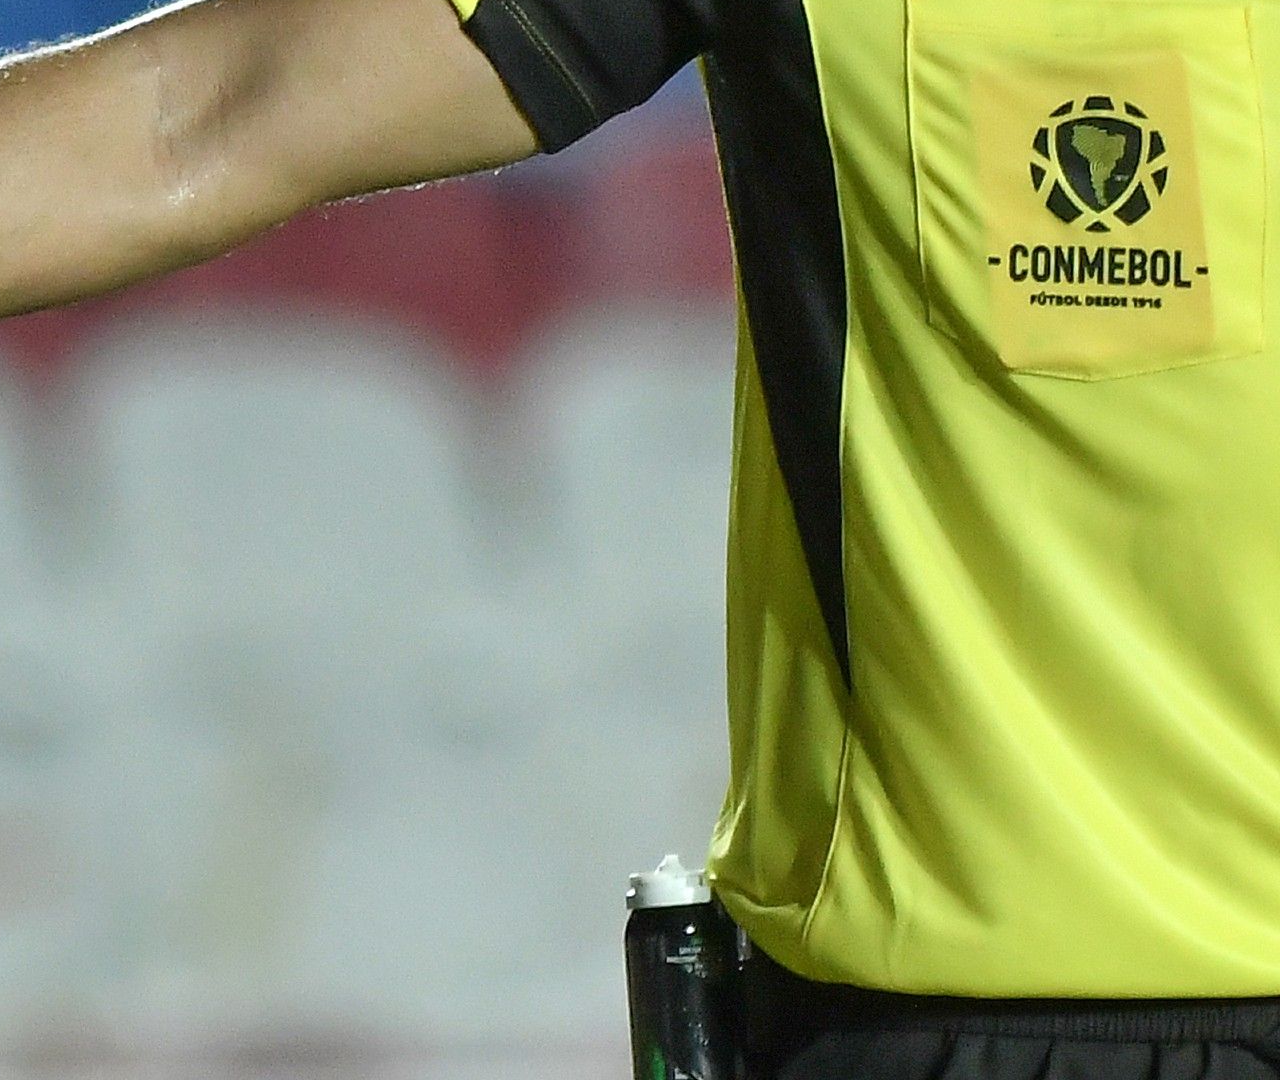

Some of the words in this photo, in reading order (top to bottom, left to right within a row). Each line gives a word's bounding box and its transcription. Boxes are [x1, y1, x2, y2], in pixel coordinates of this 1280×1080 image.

[1030, 291, 1082, 307] FÚTBOL
[1085, 295, 1128, 308] DESDE
[1132, 297, 1163, 309] 1916
